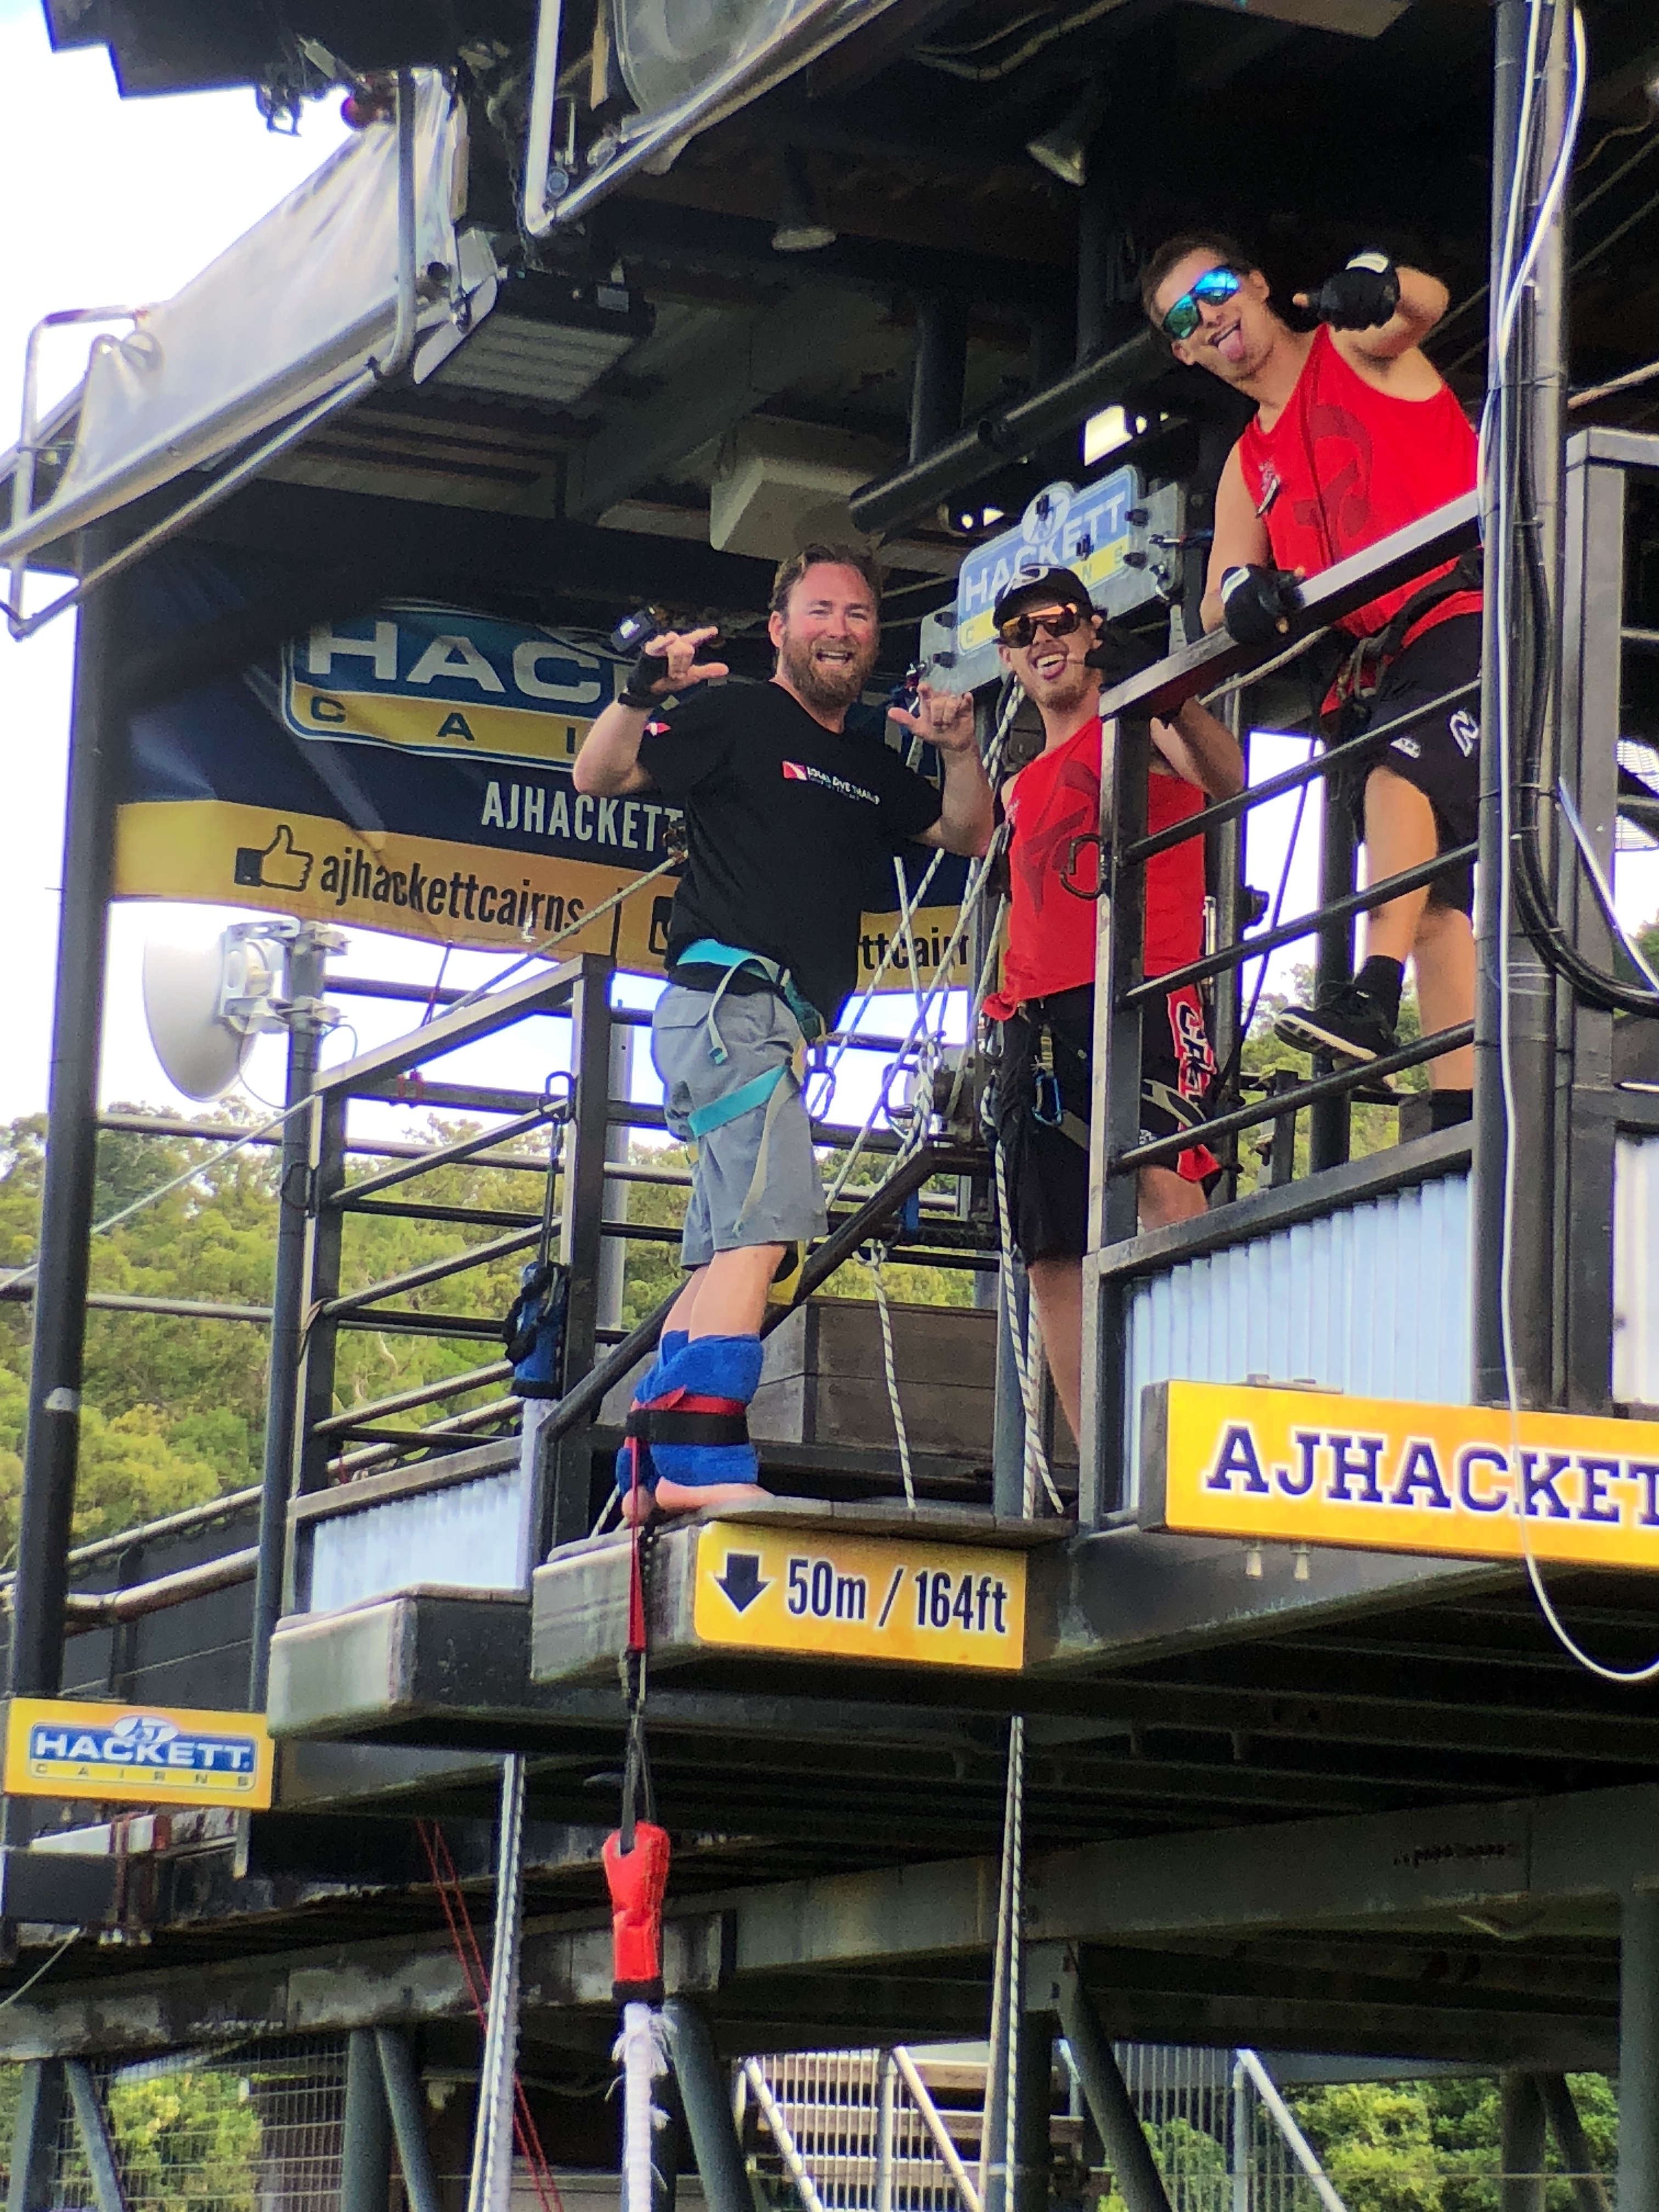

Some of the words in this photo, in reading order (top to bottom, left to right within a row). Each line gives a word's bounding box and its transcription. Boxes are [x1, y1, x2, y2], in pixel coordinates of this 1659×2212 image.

[320, 846, 584, 935] ajhackettcairns
[788, 1558, 866, 1620] 50m
[878, 1568, 904, 1627] /
[915, 1570, 1007, 1633] 164ft
[36, 1763, 249, 1786] CAIRNS
